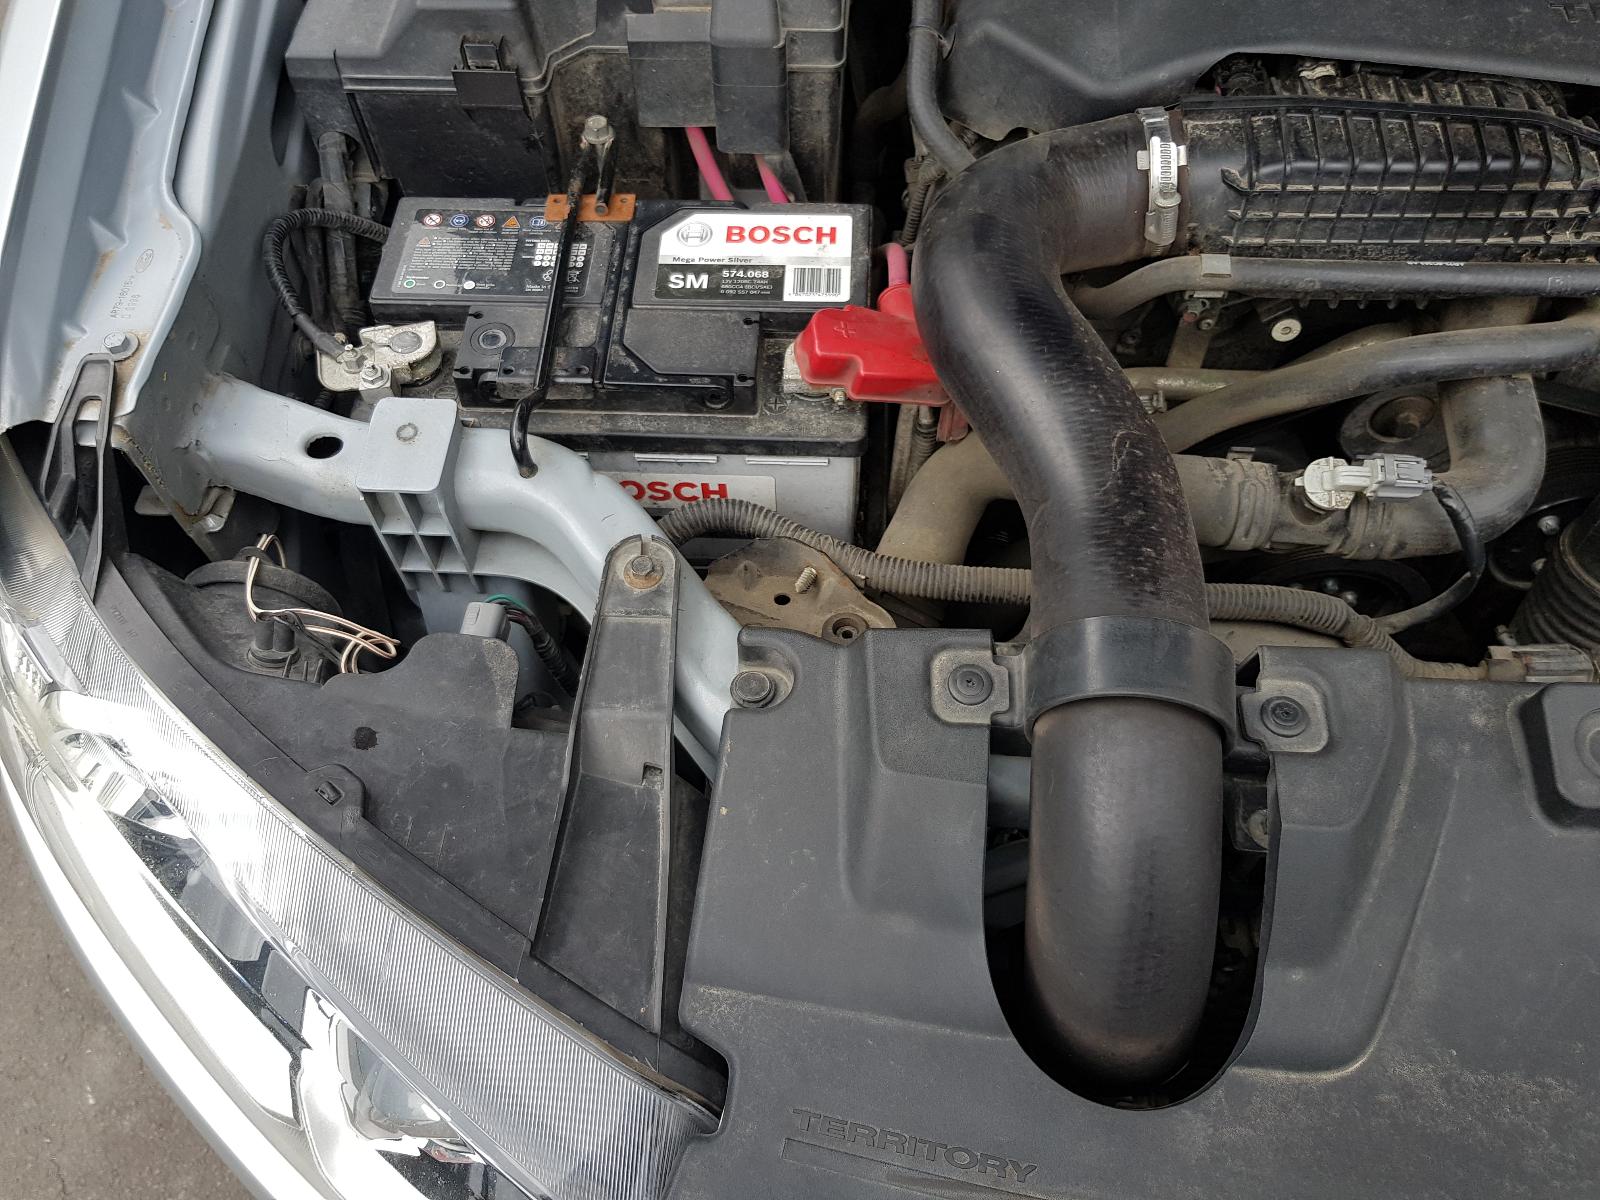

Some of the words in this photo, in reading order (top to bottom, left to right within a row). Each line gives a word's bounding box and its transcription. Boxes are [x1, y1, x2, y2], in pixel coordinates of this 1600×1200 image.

[725, 225, 838, 245] BOSCH
[672, 256, 696, 264] Mega
[668, 273, 709, 289] SM
[721, 270, 770, 278] 574.068
[619, 480, 729, 502] OSCH
[792, 1108, 1038, 1183] TERRITORY
